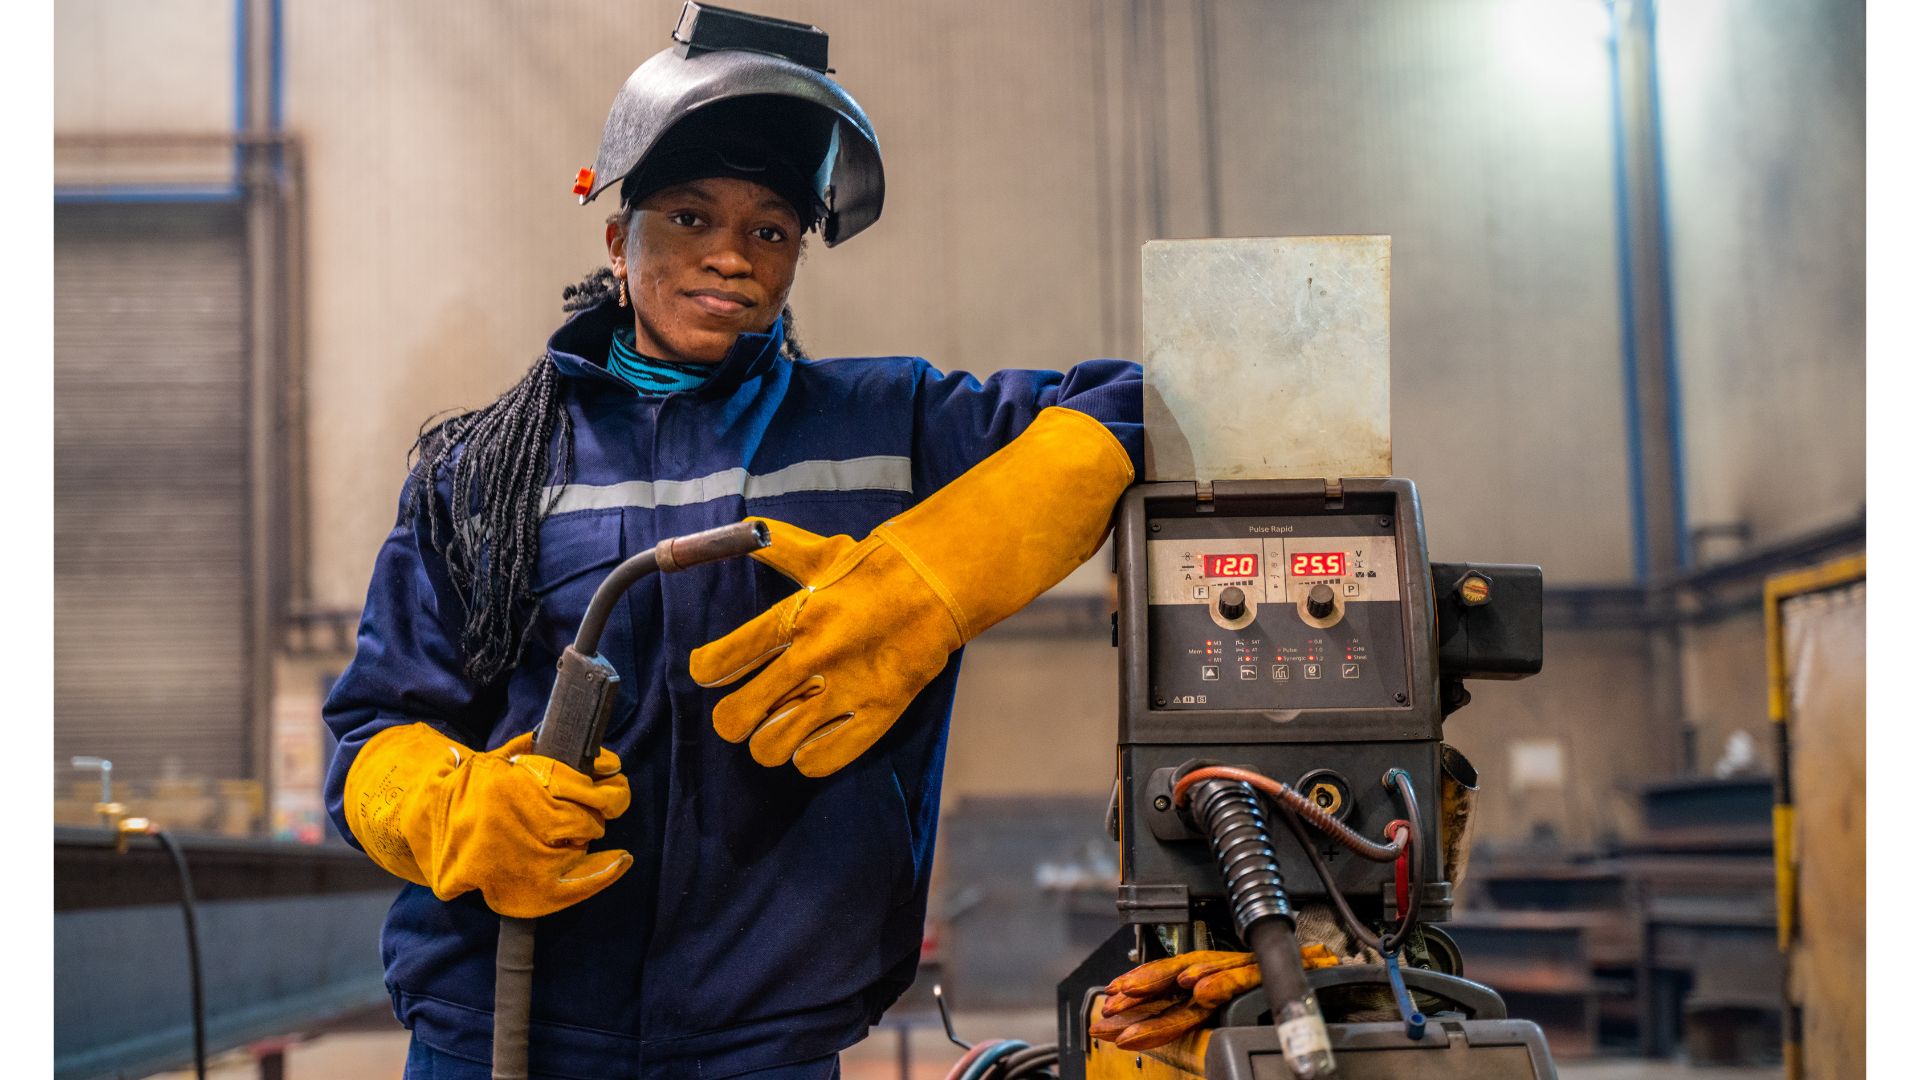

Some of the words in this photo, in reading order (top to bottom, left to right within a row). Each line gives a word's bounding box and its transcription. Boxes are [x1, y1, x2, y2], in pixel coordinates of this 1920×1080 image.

[1249, 525, 1269, 533] Pulse
[1271, 525, 1293, 534] Rapid
[1215, 557, 1253, 576] 12.0
[1294, 555, 1339, 574] 25.5
[1185, 573, 1192, 581] A
[1198, 587, 1204, 596] F
[1348, 585, 1355, 593] P
